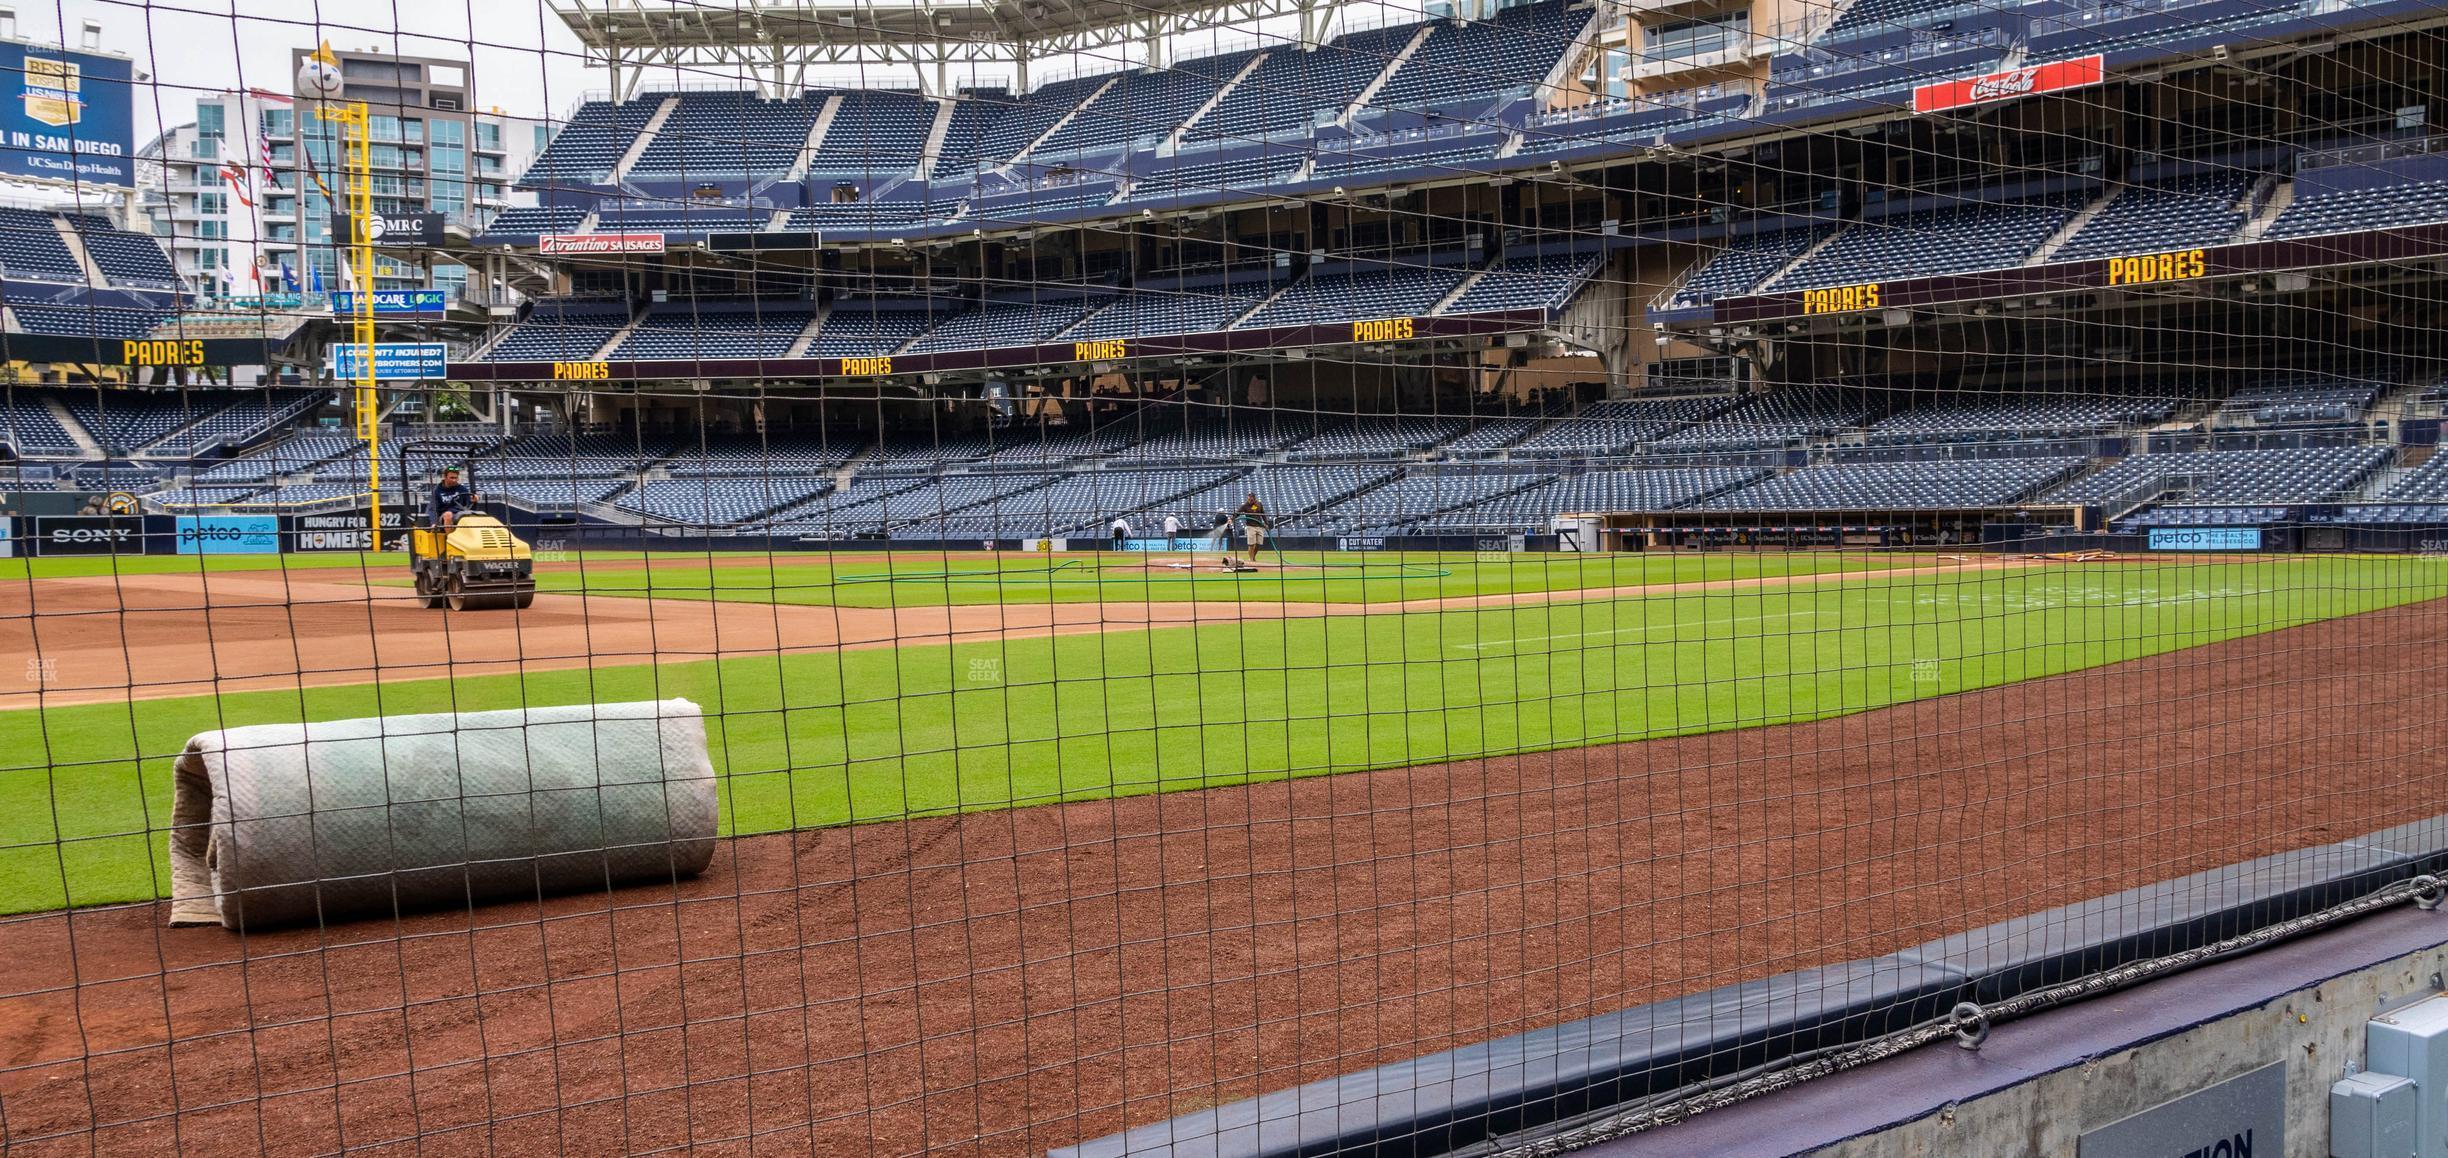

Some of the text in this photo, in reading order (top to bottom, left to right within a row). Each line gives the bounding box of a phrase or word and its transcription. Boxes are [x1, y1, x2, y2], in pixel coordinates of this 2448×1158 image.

[29, 60, 76, 79] BEST
[1970, 69, 2038, 100] Coca-Cola
[12, 132, 30, 147] IN
[35, 135, 69, 152] SAN
[74, 139, 122, 156] DIEGO
[27, 156, 122, 176] UC San Diego Health
[385, 219, 423, 231] MRC
[543, 238, 662, 251] Tarantino SAUSAGES
[2110, 249, 2205, 286] PADRES
[352, 294, 405, 305] LADCARE
[1803, 283, 1879, 315] PADRES
[1354, 319, 1413, 341] PADRES
[123, 340, 204, 365] PADRES
[1075, 340, 1125, 361] PADRES
[554, 362, 608, 379] PADRES
[842, 357, 891, 375] PADRES
[304, 517, 367, 528] HUNGRY FOR
[380, 513, 401, 526] 322
[52, 528, 131, 543] SONY
[183, 524, 241, 546] petco
[300, 531, 372, 549] HOMERS
[1348, 538, 1383, 546] CUTWATER
[2153, 532, 2202, 546] petco
[484, 561, 519, 569] WACKER
